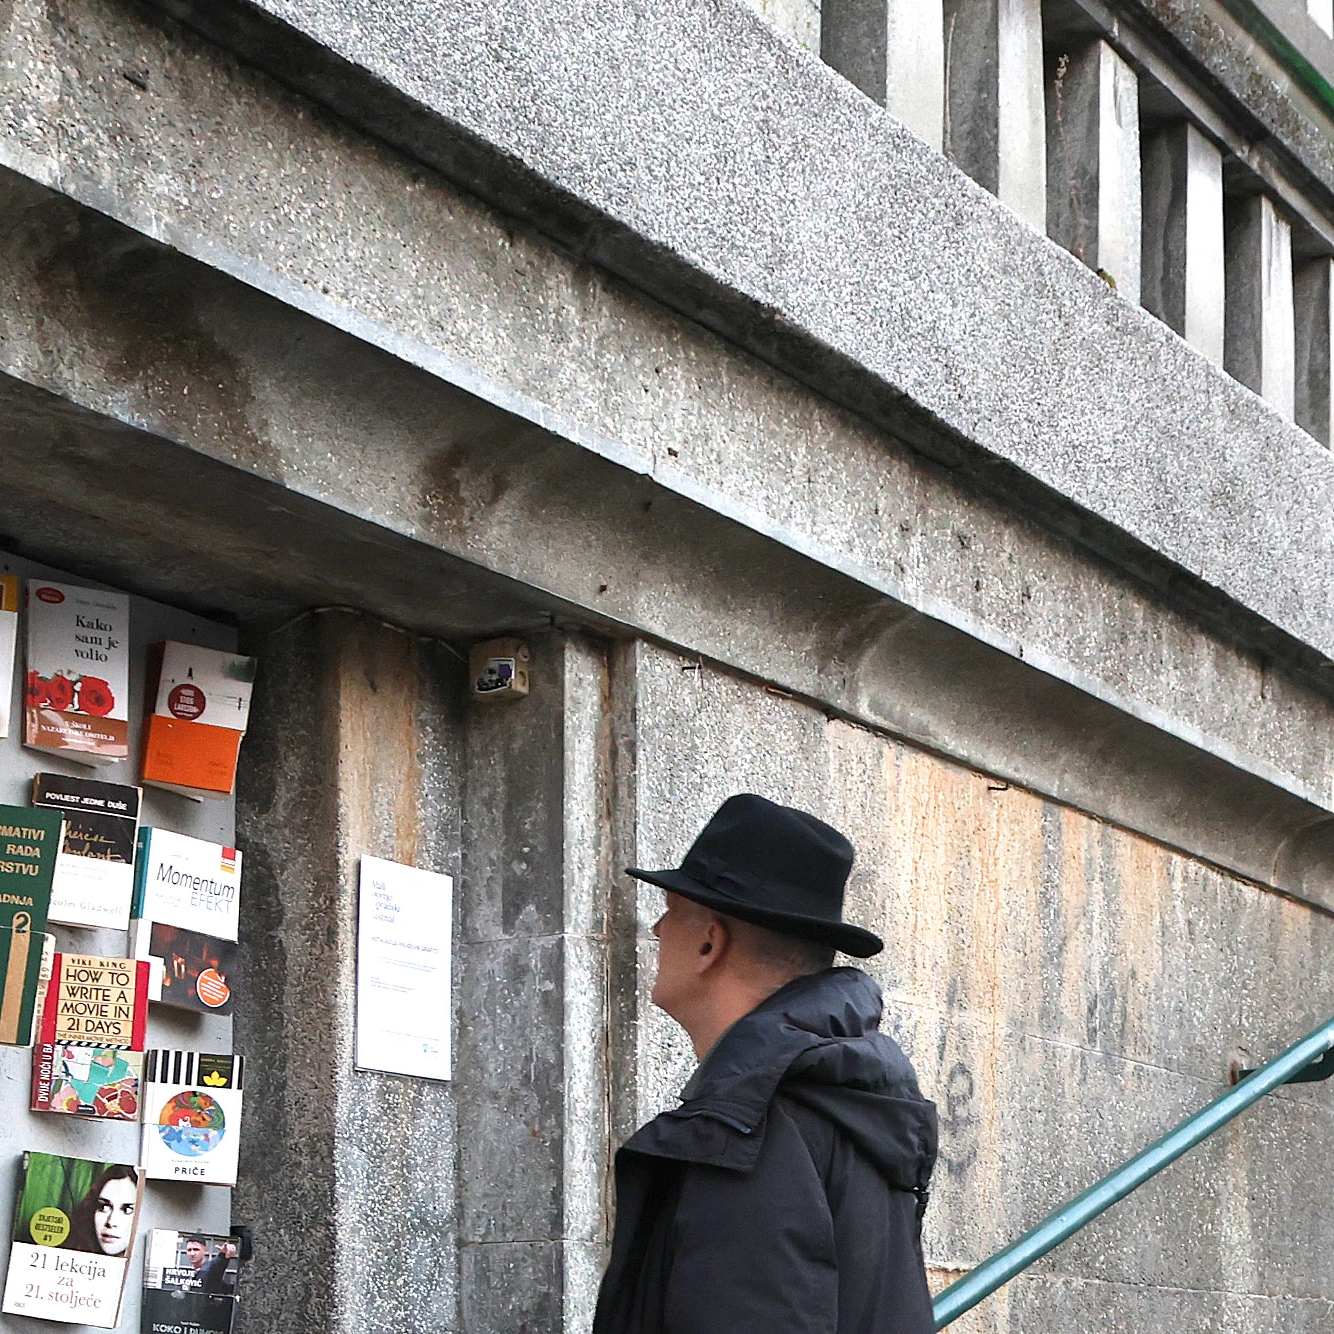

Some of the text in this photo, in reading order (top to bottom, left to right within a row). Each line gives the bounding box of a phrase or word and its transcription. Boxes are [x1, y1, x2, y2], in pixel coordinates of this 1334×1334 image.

[75, 614, 113, 632] Kako
[74, 633, 120, 650] sam je
[74, 648, 108, 662] volio
[5, 843, 41, 859] RADA
[156, 862, 235, 899] Momentum
[190, 891, 233, 915] EFEKT
[71, 958, 127, 970] VIKI KING
[65, 969, 130, 987] HOW TO
[67, 985, 128, 1003] WRITE A
[60, 1002, 130, 1019] MOVIE IN
[67, 1017, 122, 1035] 21 DAYS
[174, 1166, 206, 1177] PRIČE
[29, 1252, 107, 1280] 21 lekcija
[57, 1276, 74, 1287] za
[152, 1323, 182, 1334] KOKO
